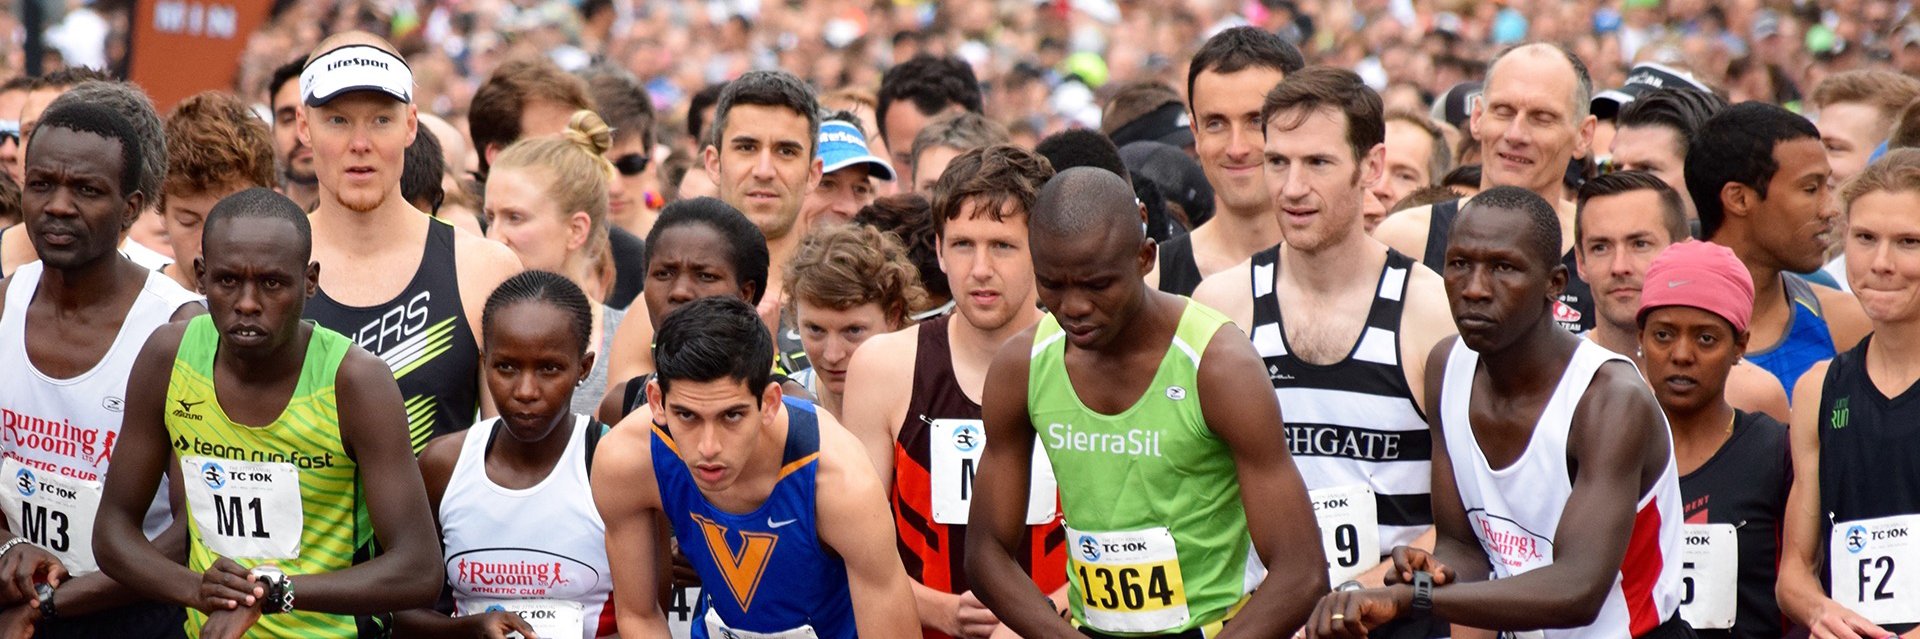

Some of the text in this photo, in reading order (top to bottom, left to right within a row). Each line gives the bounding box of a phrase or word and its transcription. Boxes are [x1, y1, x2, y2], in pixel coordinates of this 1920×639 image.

[327, 57, 390, 72] LifeSport
[352, 289, 431, 355] ERS
[1, 408, 99, 456] Running
[1048, 423, 1163, 458] SierraSil
[1284, 425, 1401, 460] HGATE
[194, 437, 246, 461] team
[60, 466, 98, 481] CLUB
[229, 471, 273, 483] TC 10K
[39, 481, 55, 495] TC
[56, 485, 77, 501] 10K
[1323, 497, 1349, 510] 10K
[1684, 494, 1710, 513] RENT
[21, 500, 70, 553] M3
[213, 494, 271, 539] M1
[1334, 523, 1360, 568] 9
[1685, 536, 1711, 546] 10K
[1871, 527, 1909, 540] TC 10K
[1102, 541, 1148, 553] TC 10K
[469, 560, 550, 584] Running
[689, 511, 779, 614] V
[1079, 565, 1175, 611] 1364
[1858, 555, 1896, 603] F2
[471, 587, 546, 596] ATHLETIC CLUB
[530, 609, 557, 620] 10K
